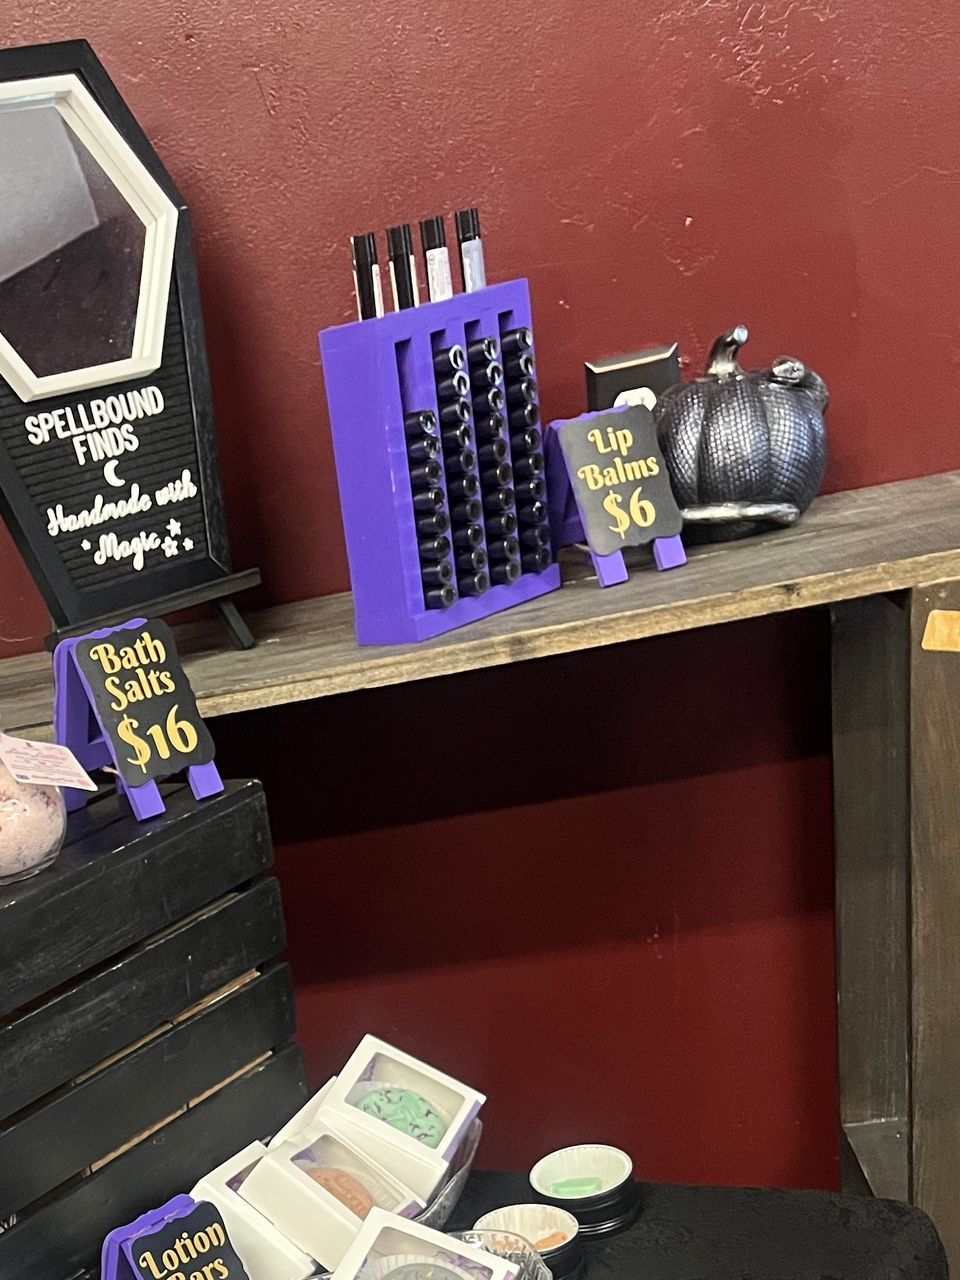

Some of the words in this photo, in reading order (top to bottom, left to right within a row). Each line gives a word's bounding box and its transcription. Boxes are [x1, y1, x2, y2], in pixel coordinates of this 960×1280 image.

[25, 386, 165, 445] SPELLBOUND
[72, 424, 139, 465] FINDS
[587, 427, 633, 456] Lip
[577, 456, 659, 490] Balms
[46, 483, 152, 536] Handmade
[155, 469, 197, 506] with
[603, 487, 656, 540] $6
[93, 531, 161, 571] Magic
[90, 632, 166, 674] Bath
[104, 668, 175, 712] Salts
[117, 704, 197, 774] $16
[139, 1223, 225, 1279] Lotion
